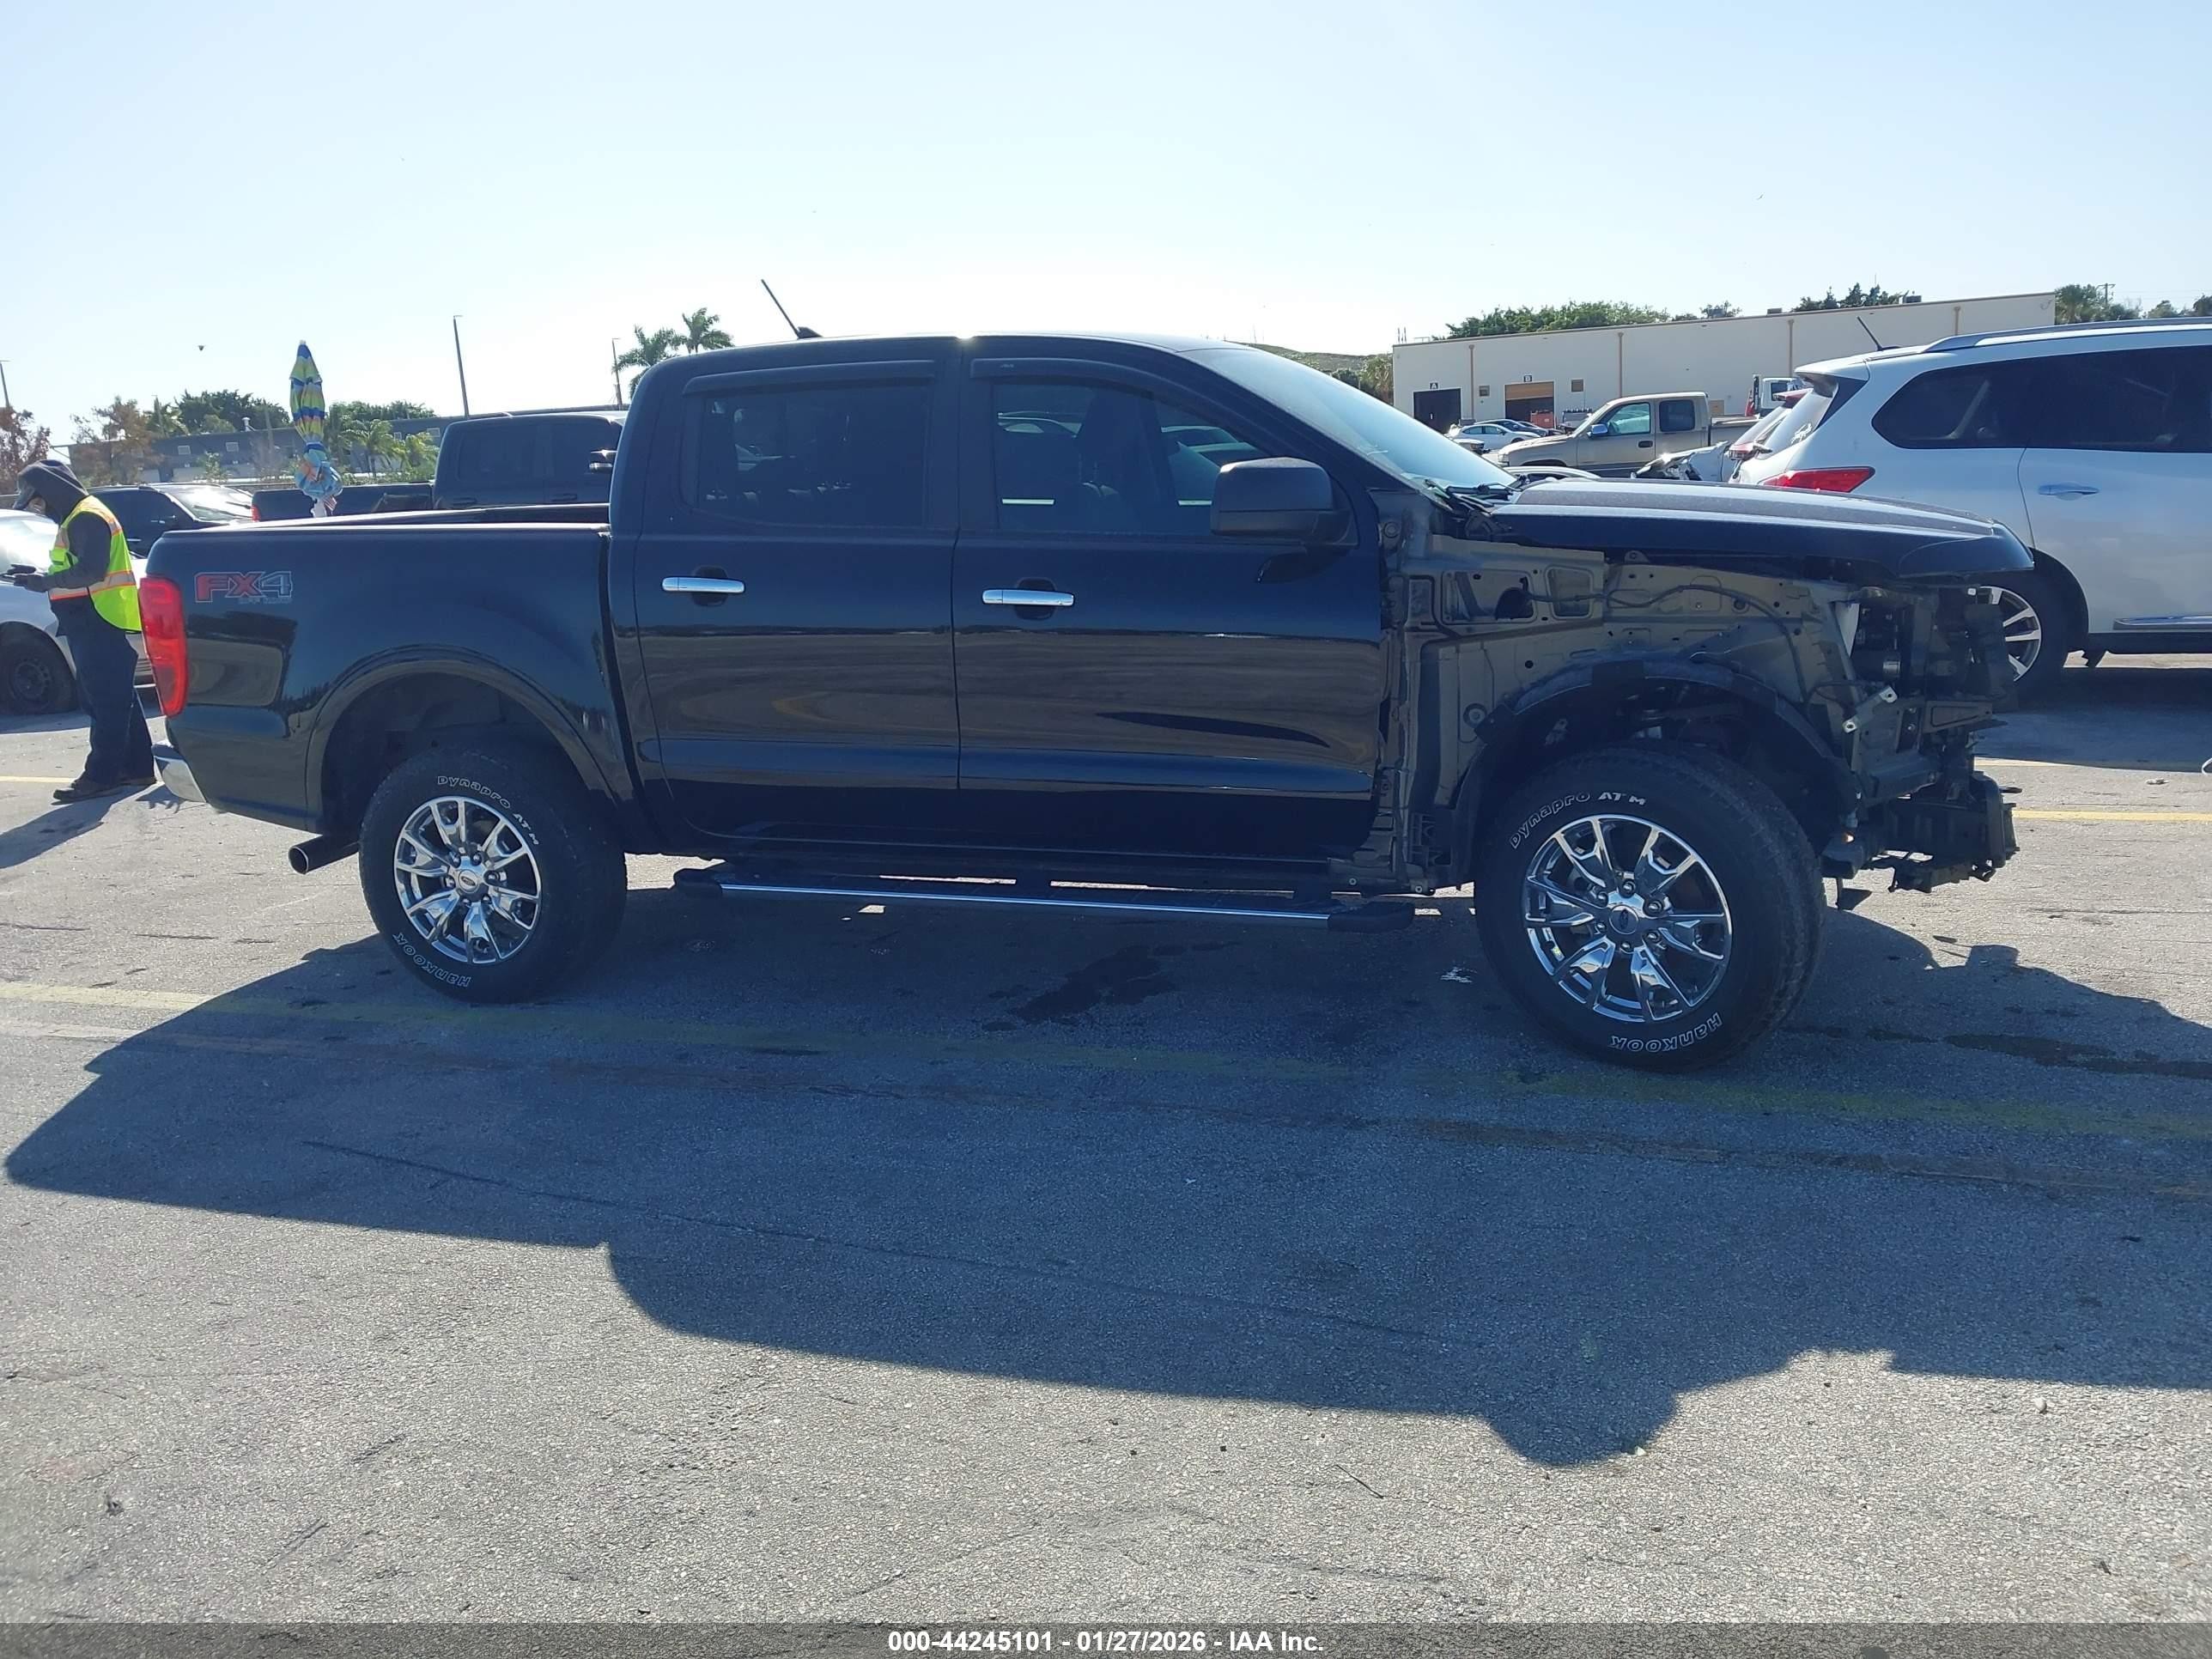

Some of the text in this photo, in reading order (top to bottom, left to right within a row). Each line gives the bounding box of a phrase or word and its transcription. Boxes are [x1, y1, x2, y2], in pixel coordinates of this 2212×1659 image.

[194, 570, 294, 603] FX4
[437, 775, 511, 809] Dynapro
[1510, 791, 1591, 848] Dynapro
